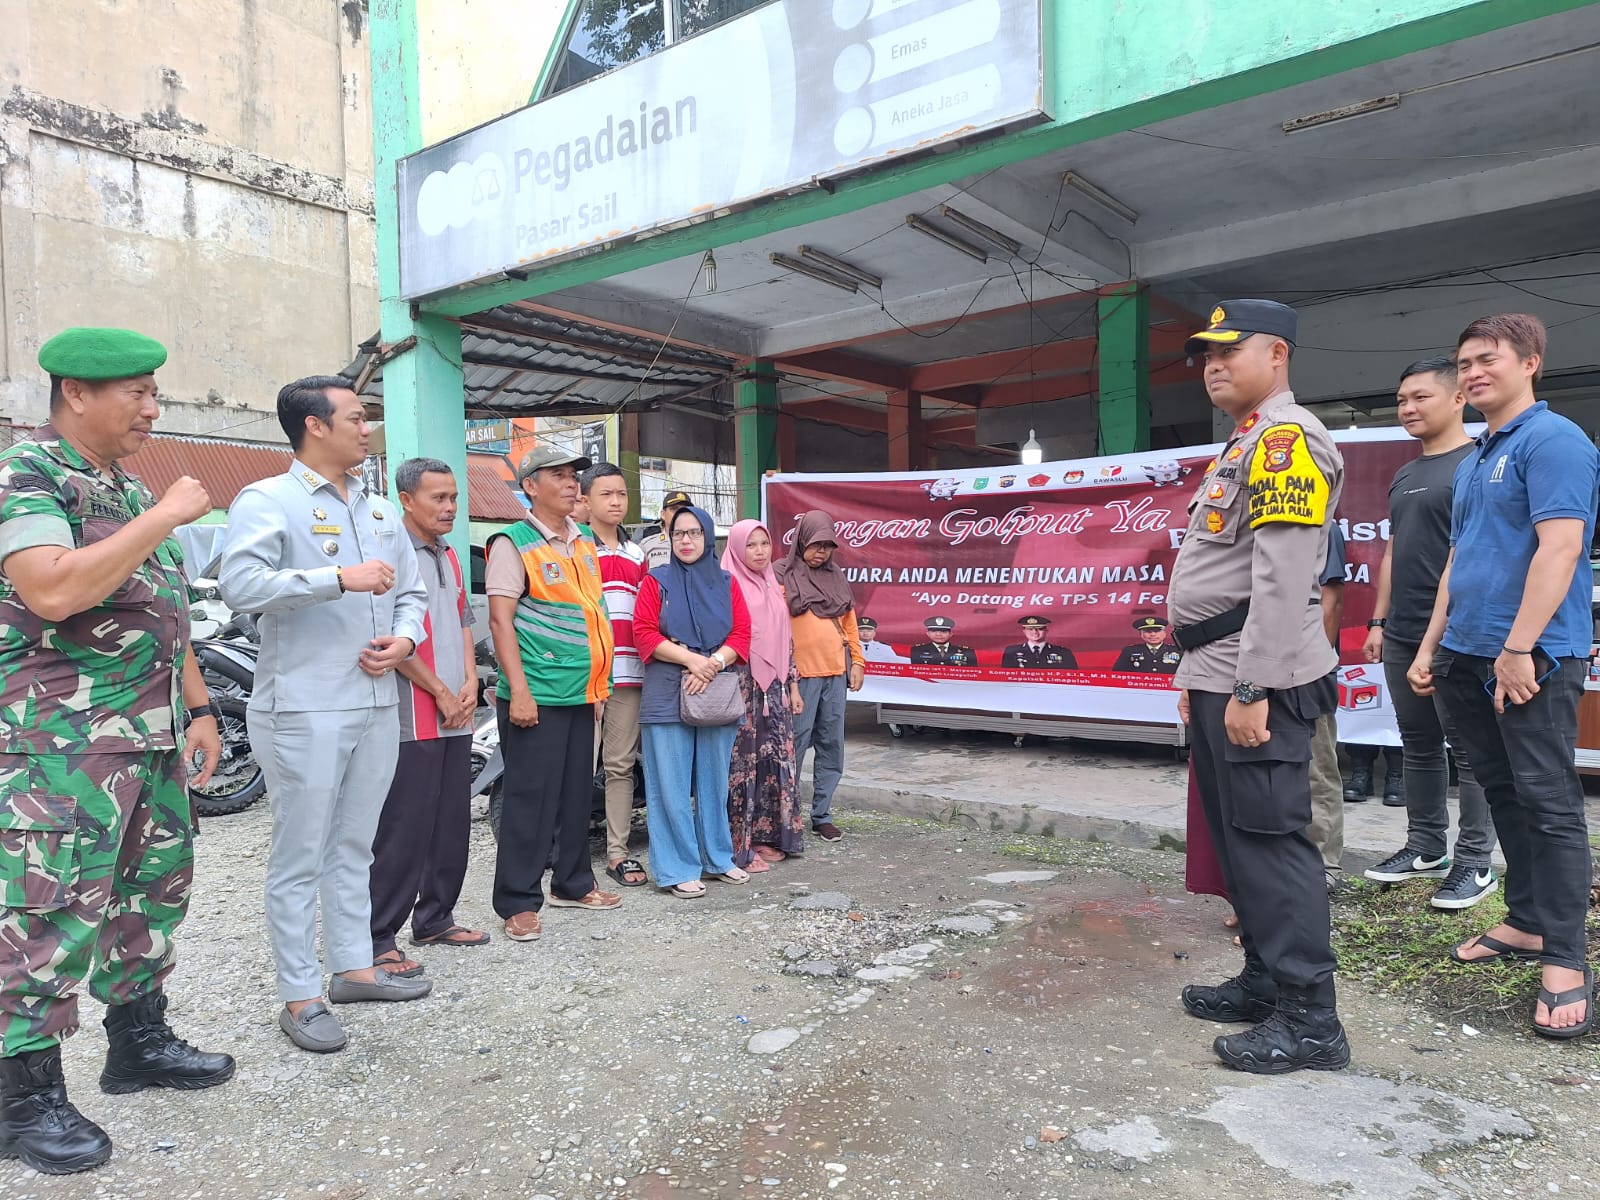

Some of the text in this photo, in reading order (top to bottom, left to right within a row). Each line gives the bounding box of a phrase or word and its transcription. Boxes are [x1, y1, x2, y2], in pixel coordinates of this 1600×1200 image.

[891, 38, 927, 60] Emas
[891, 91, 969, 126] Aneka Jasa
[514, 96, 697, 194] Pegadaian
[516, 192, 617, 249] Pasar Sail
[466, 427, 497, 443] AR SAIL
[1093, 476, 1128, 485] BAWASLU
[1285, 475, 1315, 494] PAM
[1252, 491, 1308, 510] WILAYAH
[939, 506, 1094, 545] Golput
[1104, 496, 1172, 533] Ya
[842, 567, 892, 583] UARA
[899, 567, 949, 583] ANDA
[955, 566, 1095, 584] MENENTUKAN
[1101, 564, 1165, 584] MASA
[956, 592, 1025, 609] Datang
[1029, 593, 1055, 605] Ke
[1061, 593, 1099, 606] TPS
[1107, 592, 1132, 604] 14
[1138, 592, 1169, 605] Fe
